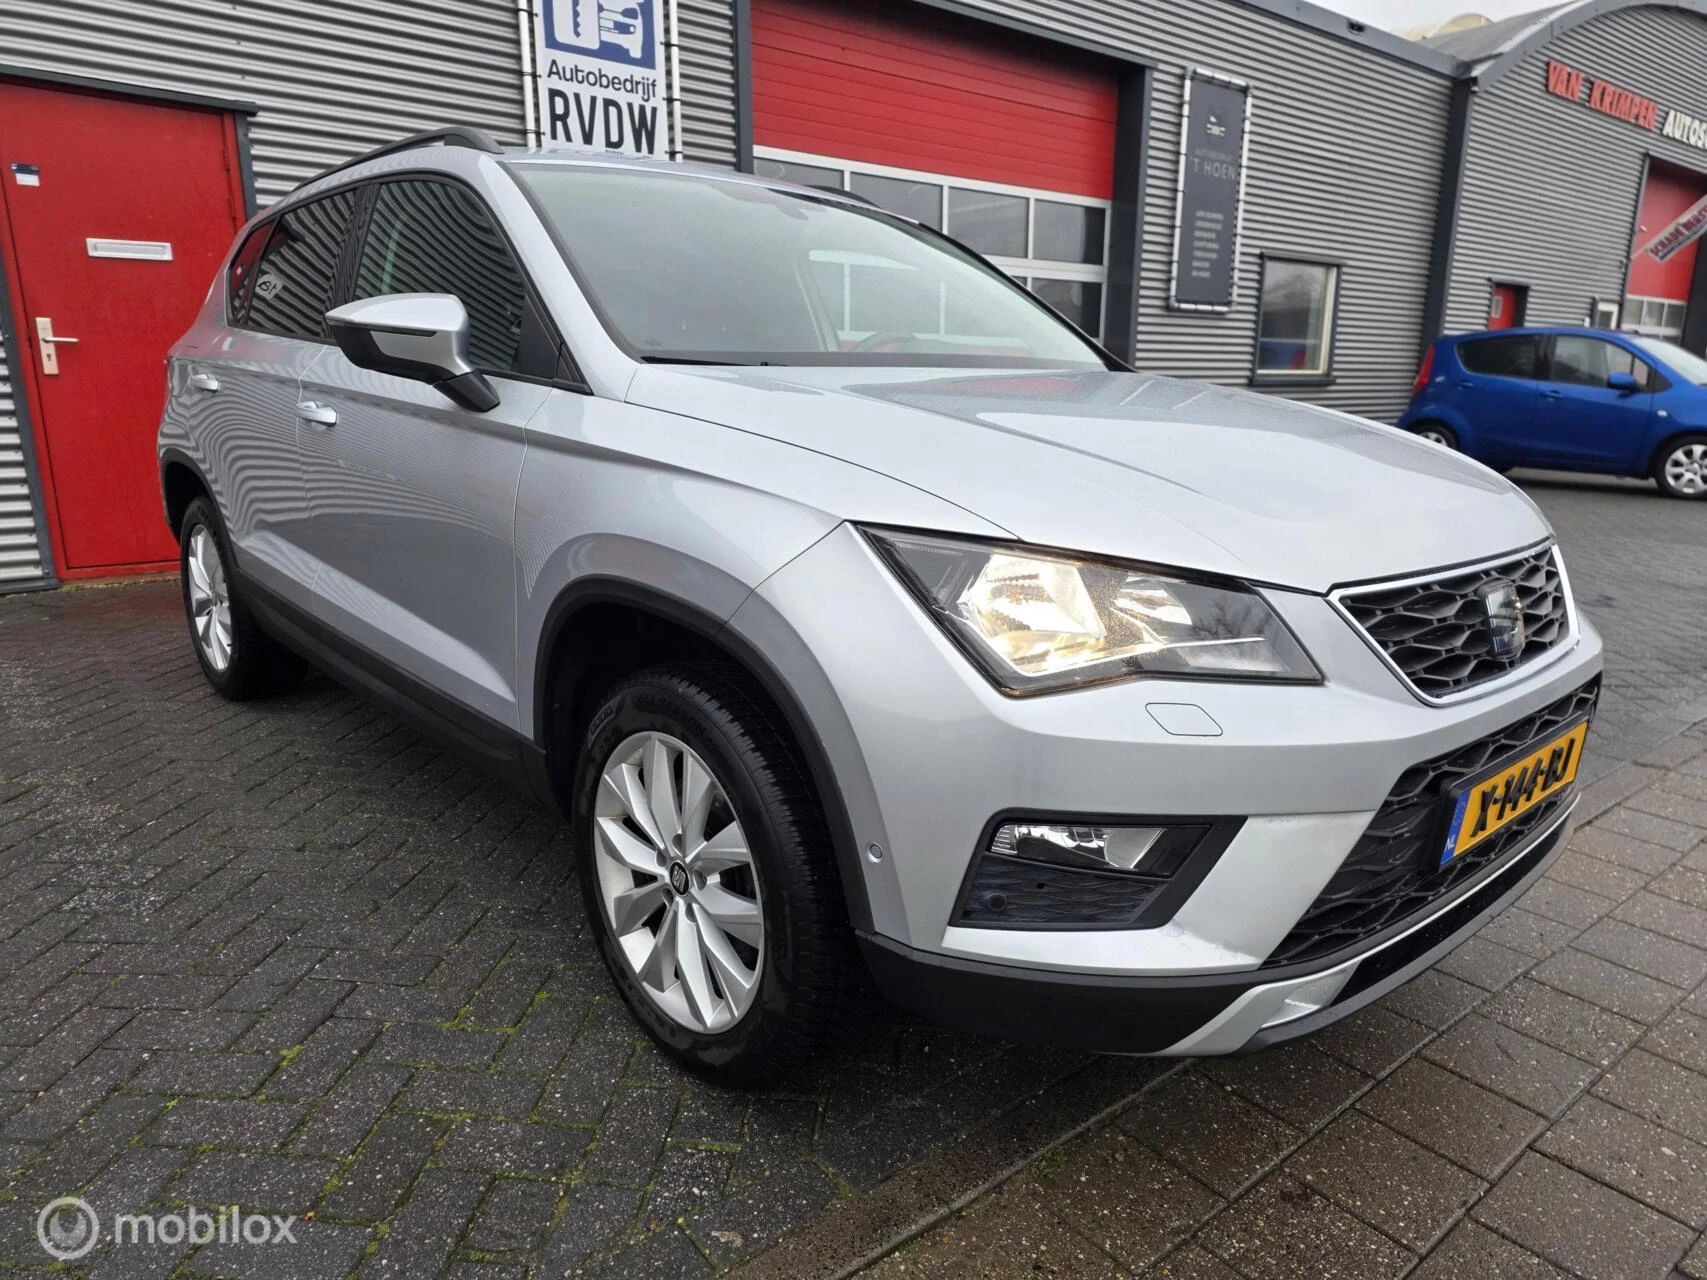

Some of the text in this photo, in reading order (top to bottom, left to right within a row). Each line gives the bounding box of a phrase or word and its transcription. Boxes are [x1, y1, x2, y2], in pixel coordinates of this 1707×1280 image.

[547, 59, 657, 102] Autobedrijf
[1548, 58, 1707, 149] VAN KRIMPEN AUTOS
[548, 87, 658, 155] RVDW
